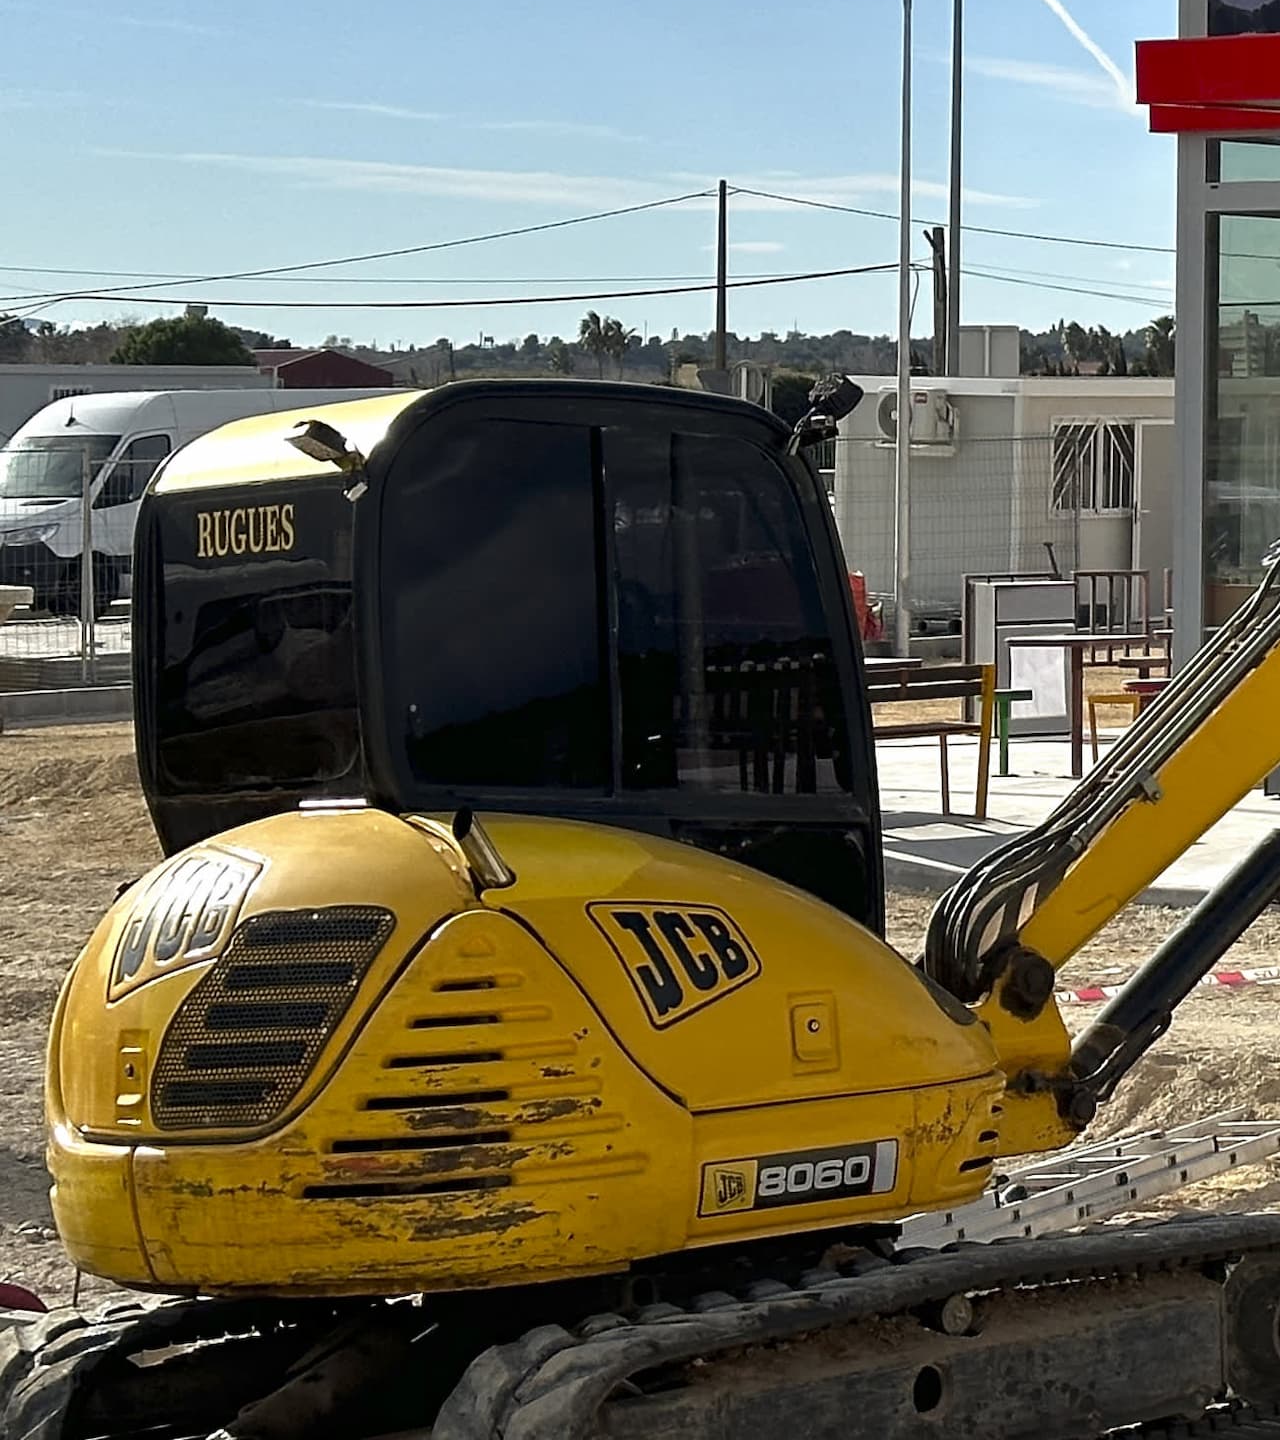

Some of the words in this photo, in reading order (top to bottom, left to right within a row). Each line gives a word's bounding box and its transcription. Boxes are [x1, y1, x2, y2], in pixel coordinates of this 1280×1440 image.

[197, 504, 294, 557] RUGUES
[114, 857, 246, 986] JCB
[610, 911, 750, 1017] JCB
[757, 1155, 871, 1197] 8060
